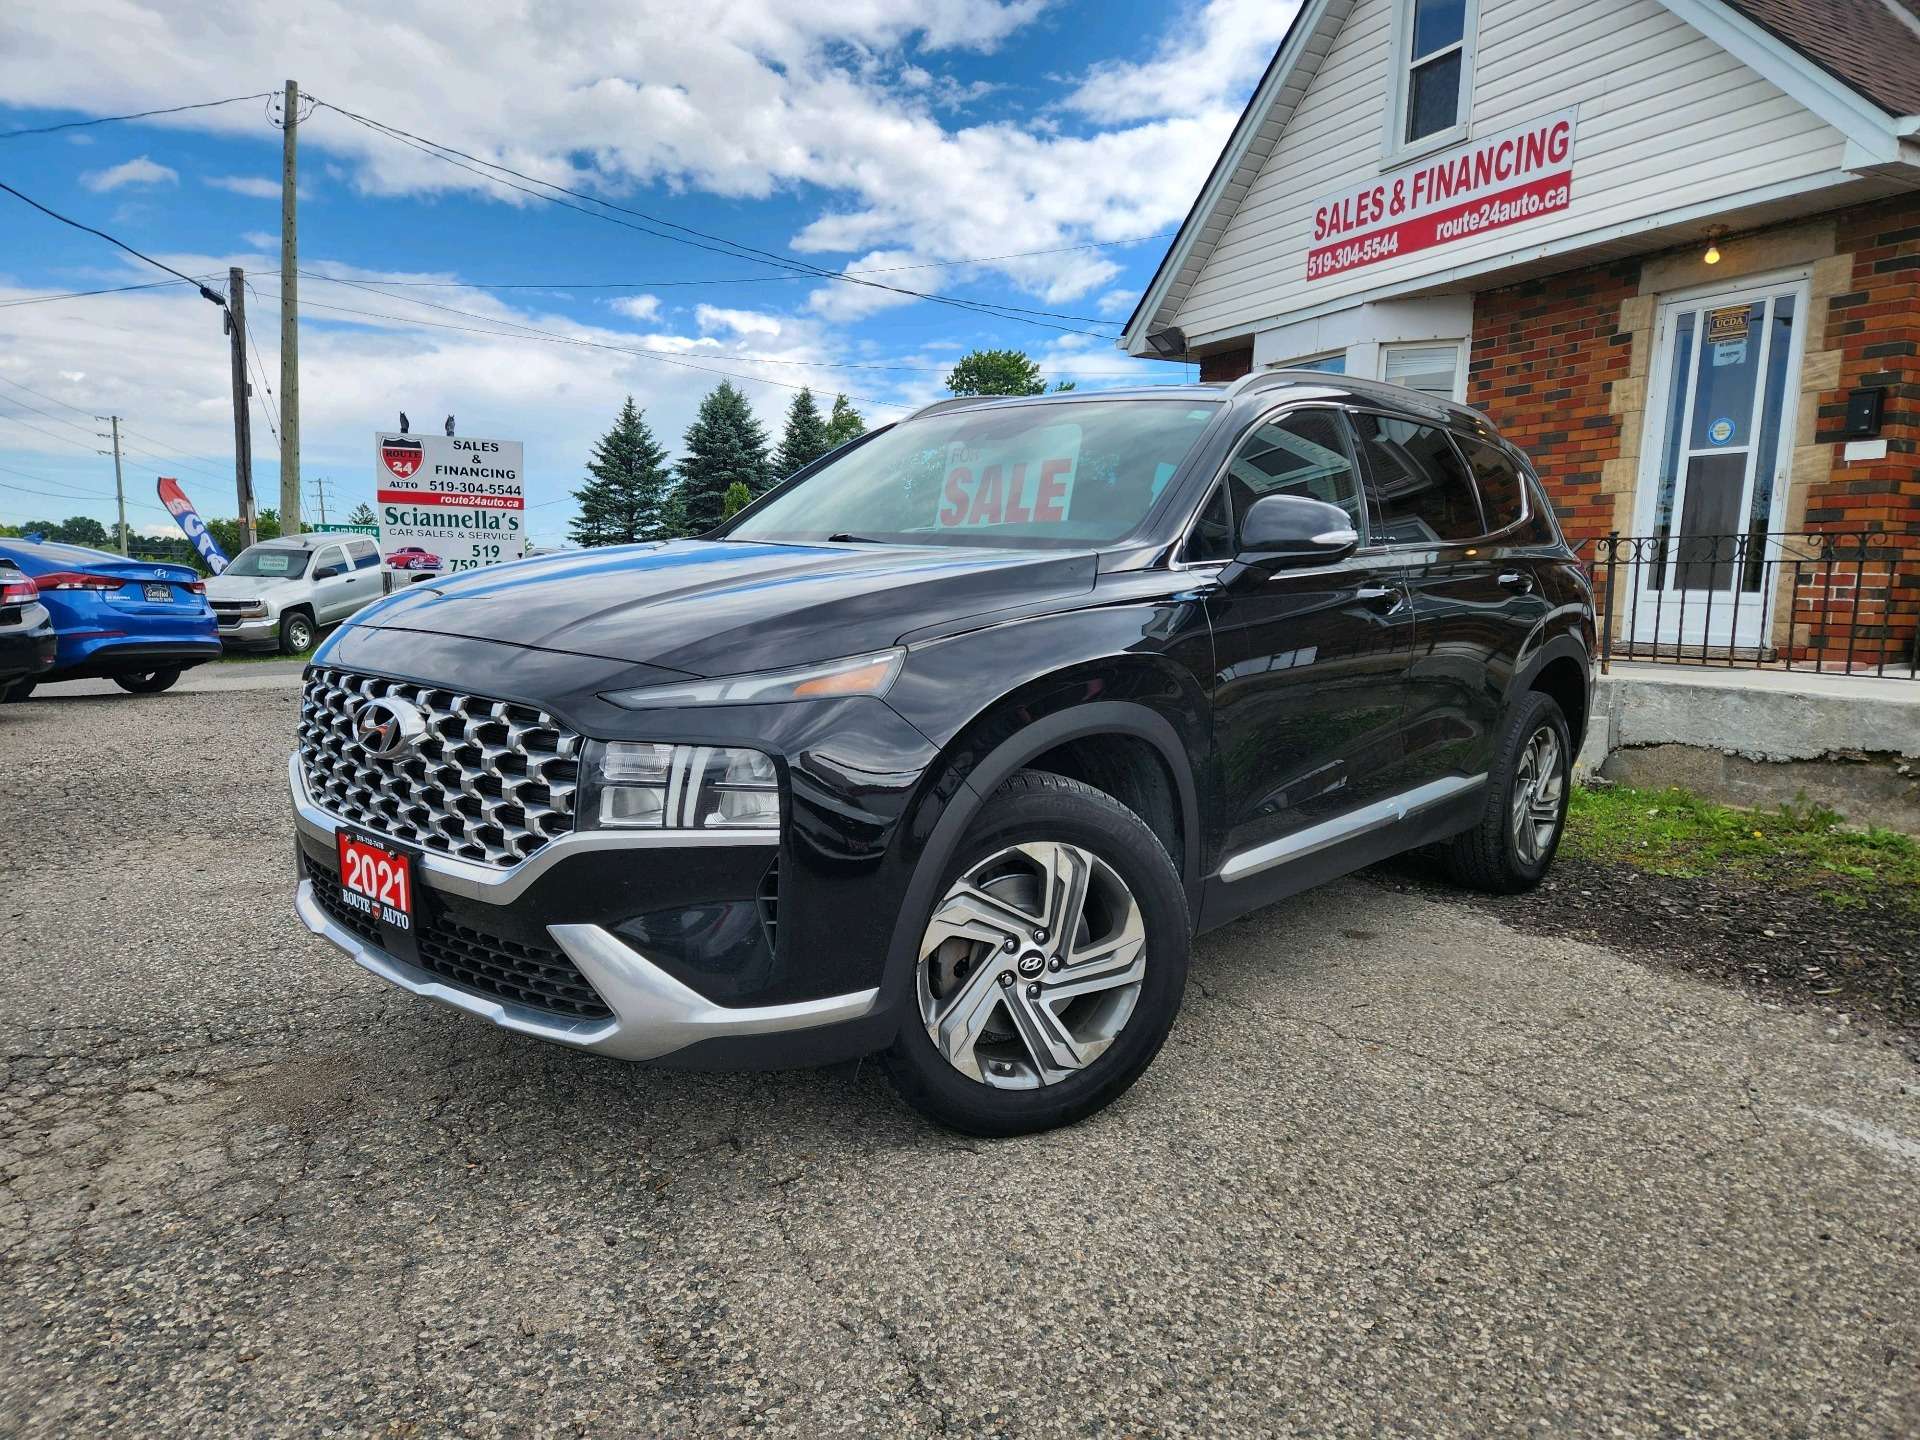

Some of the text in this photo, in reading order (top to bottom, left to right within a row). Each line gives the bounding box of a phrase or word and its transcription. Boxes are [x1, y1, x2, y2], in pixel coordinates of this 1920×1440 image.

[1314, 120, 1570, 241] SALES & FINANCING
[1308, 186, 1568, 277] 519-304-5544 route24auto.ca
[1716, 317, 1744, 328] UCDA
[453, 440, 499, 452] SALES
[472, 454, 482, 464] &
[392, 461, 413, 475] 24
[436, 465, 516, 480] FINANCING
[389, 480, 418, 489] AUTO
[430, 480, 521, 496] 519-304-5544
[940, 458, 1073, 527] SALE
[440, 494, 519, 508] route24auto.ca
[385, 506, 519, 531] Sciannella's
[330, 526, 376, 535] Cambridge
[390, 528, 516, 541] CAR SALES & SERVICE
[472, 544, 500, 558] 519
[346, 848, 406, 912] 2021
[342, 888, 409, 930] ROUTE AUTO
